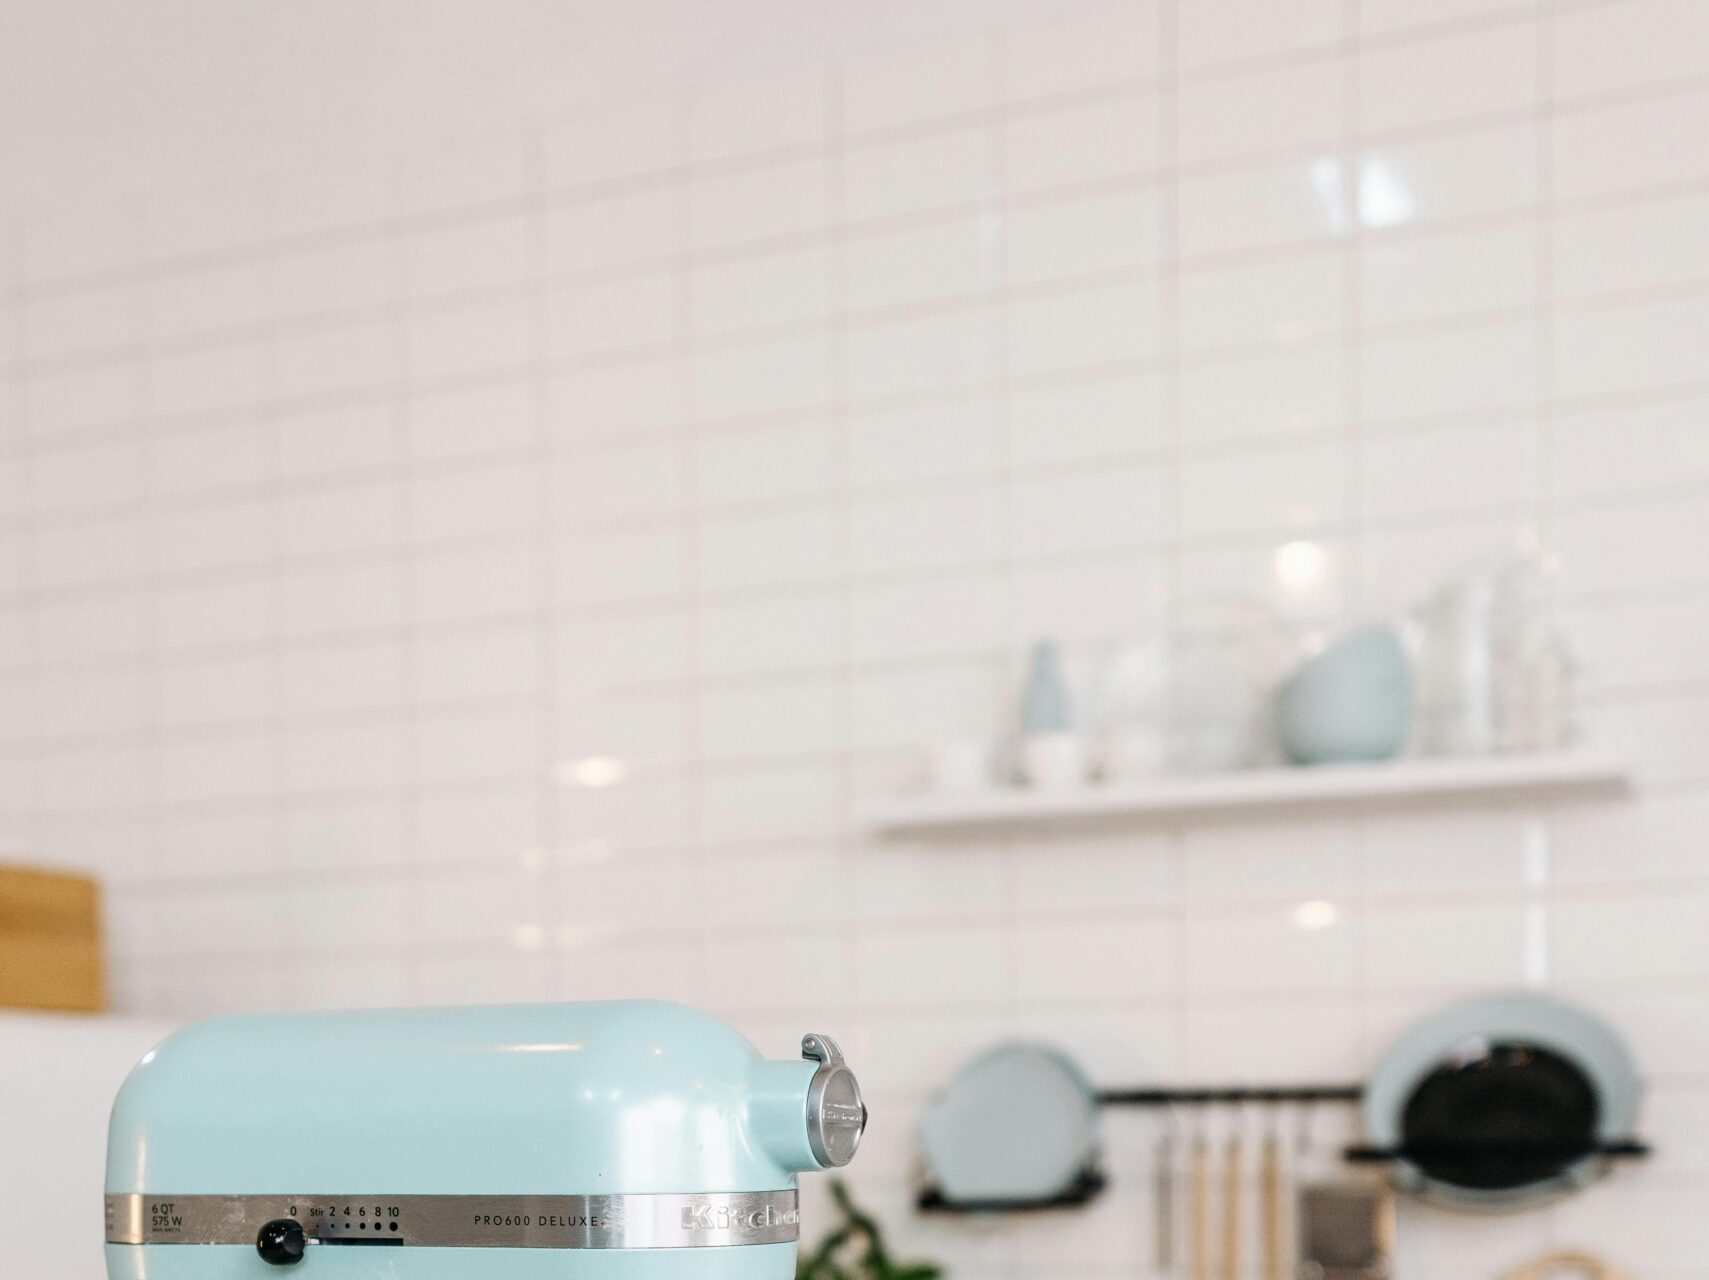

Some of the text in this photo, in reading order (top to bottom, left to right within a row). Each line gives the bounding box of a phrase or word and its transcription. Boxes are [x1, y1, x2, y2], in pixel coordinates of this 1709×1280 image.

[152, 1204, 174, 1215] 6 QT
[290, 1206, 400, 1217] 0 Stir 2 4 6 8 10
[152, 1216, 182, 1226] 575 W
[474, 1215, 598, 1226] PRO600 DELUXE
